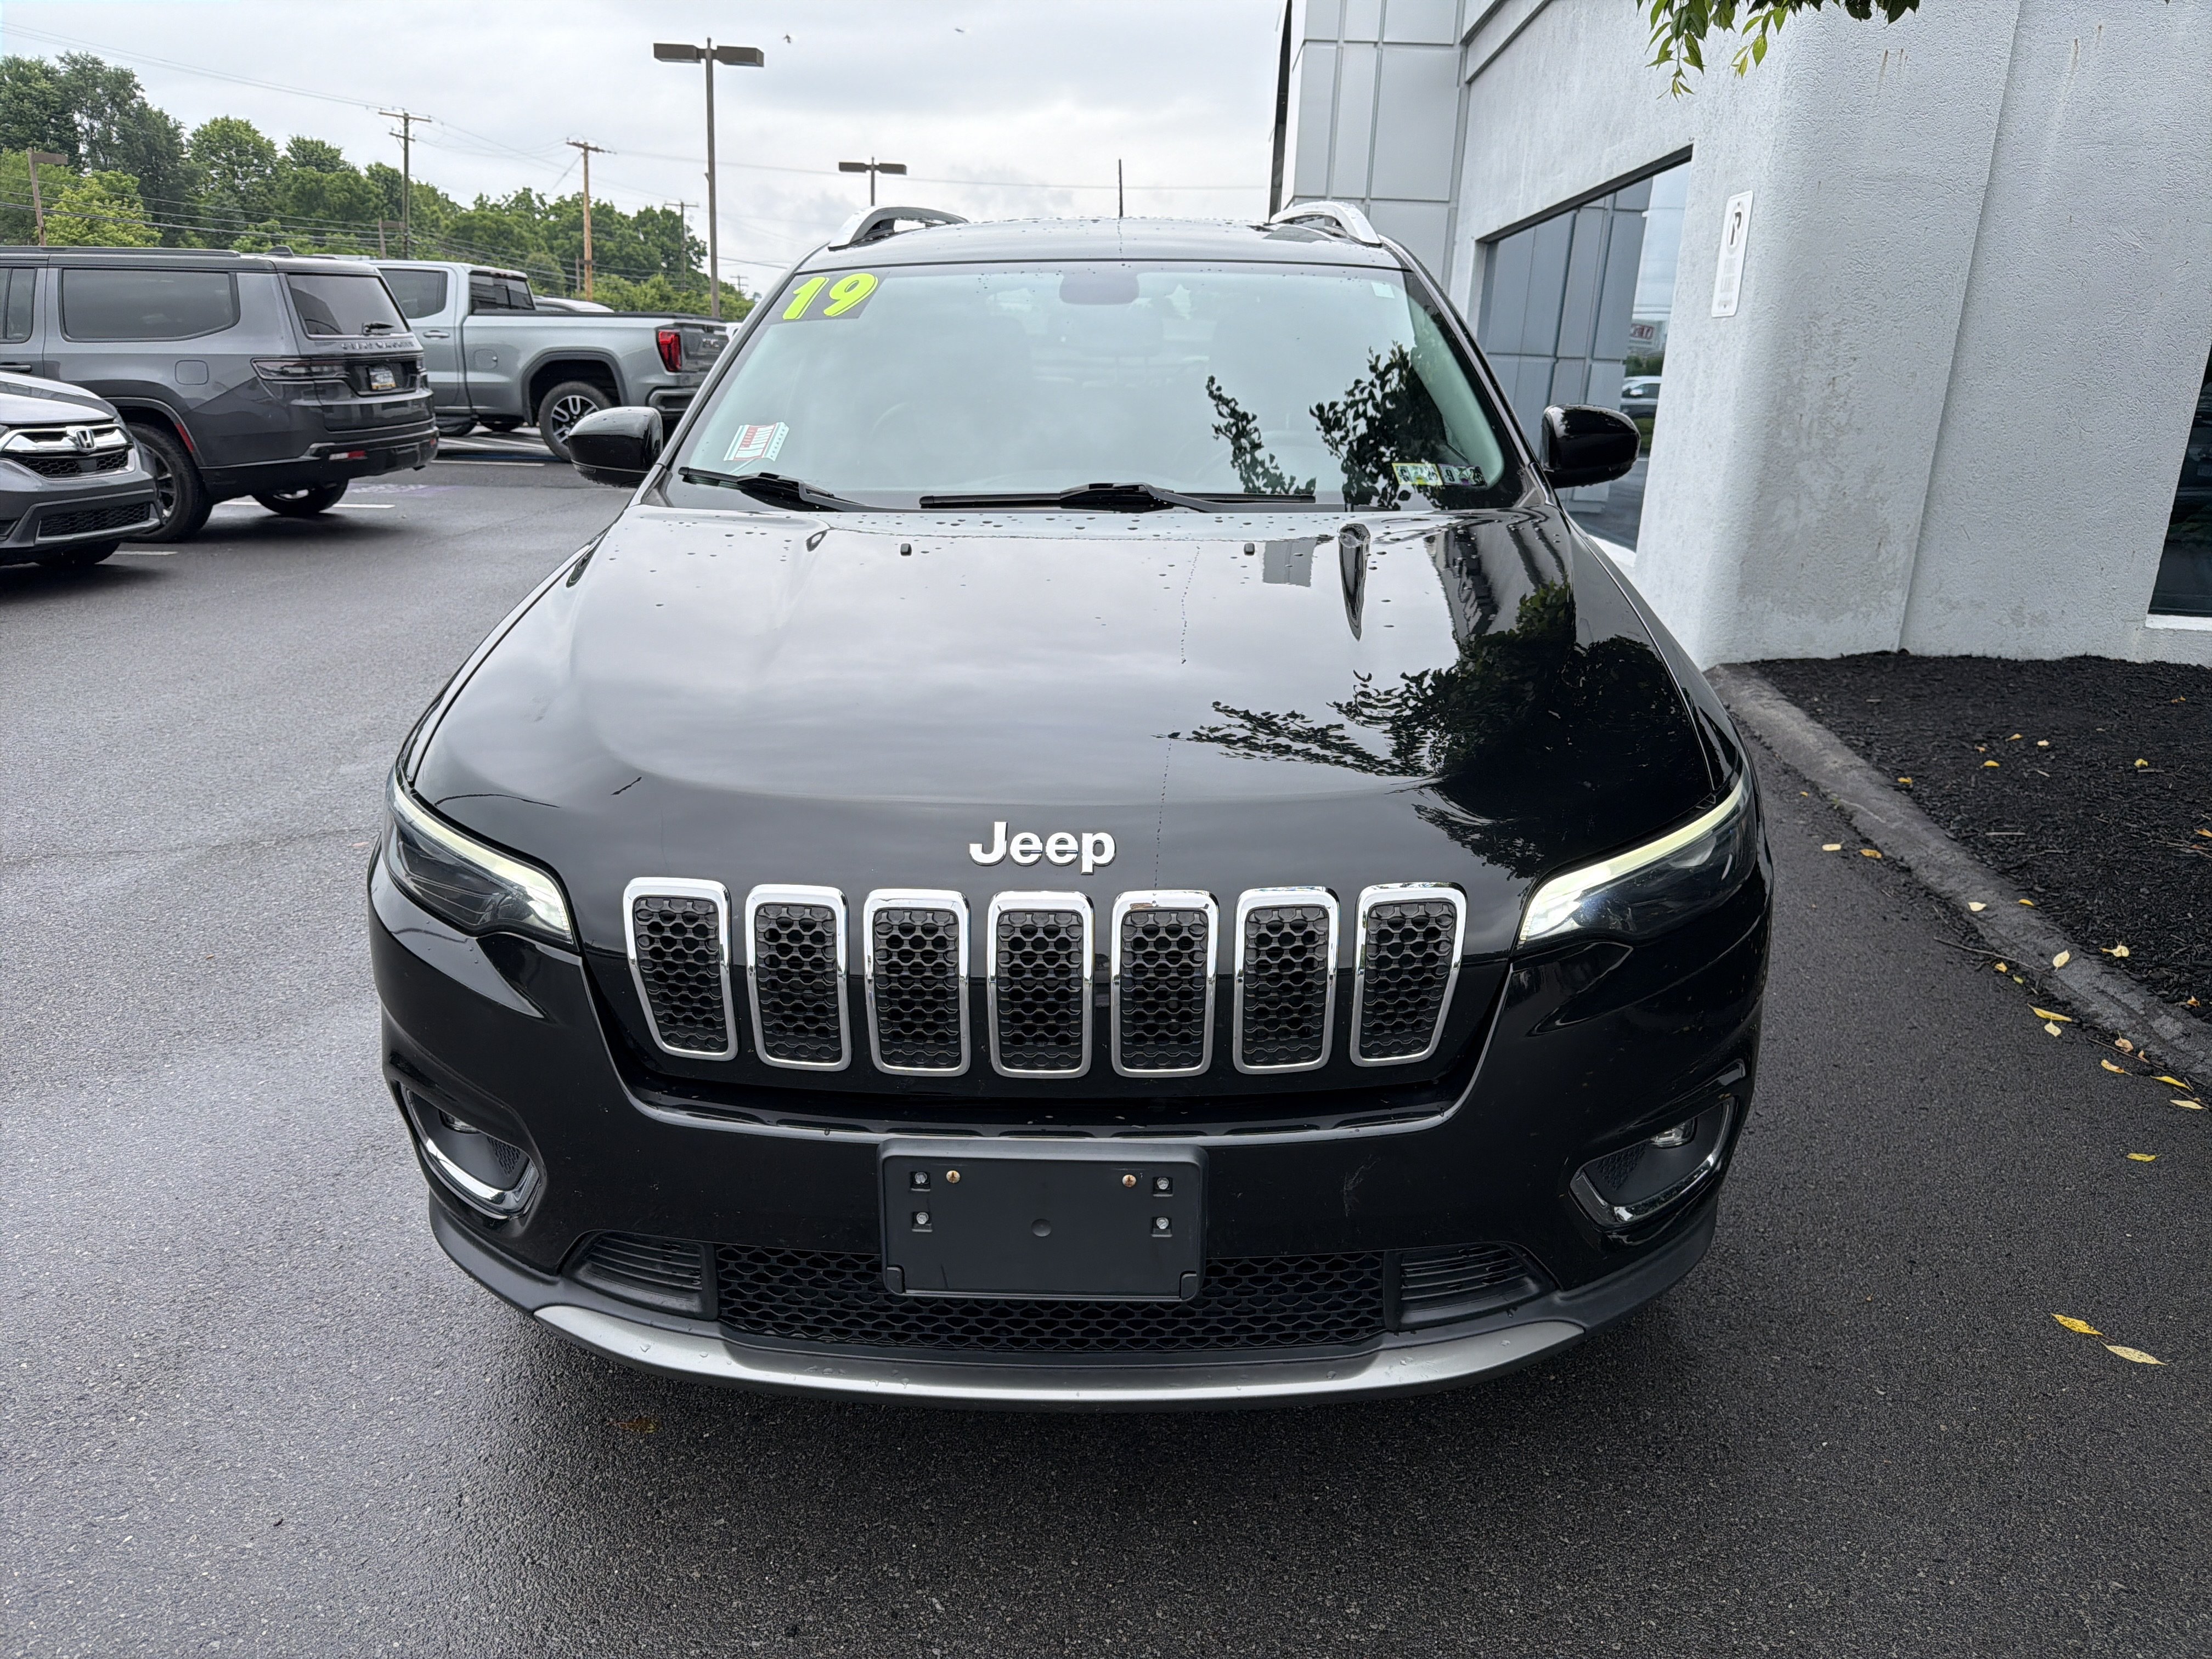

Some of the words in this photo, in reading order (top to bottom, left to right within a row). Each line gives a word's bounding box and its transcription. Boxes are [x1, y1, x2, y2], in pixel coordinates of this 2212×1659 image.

[782, 273, 878, 320] 19
[1445, 469, 1455, 482] 9
[969, 821, 1116, 875] Jeep
